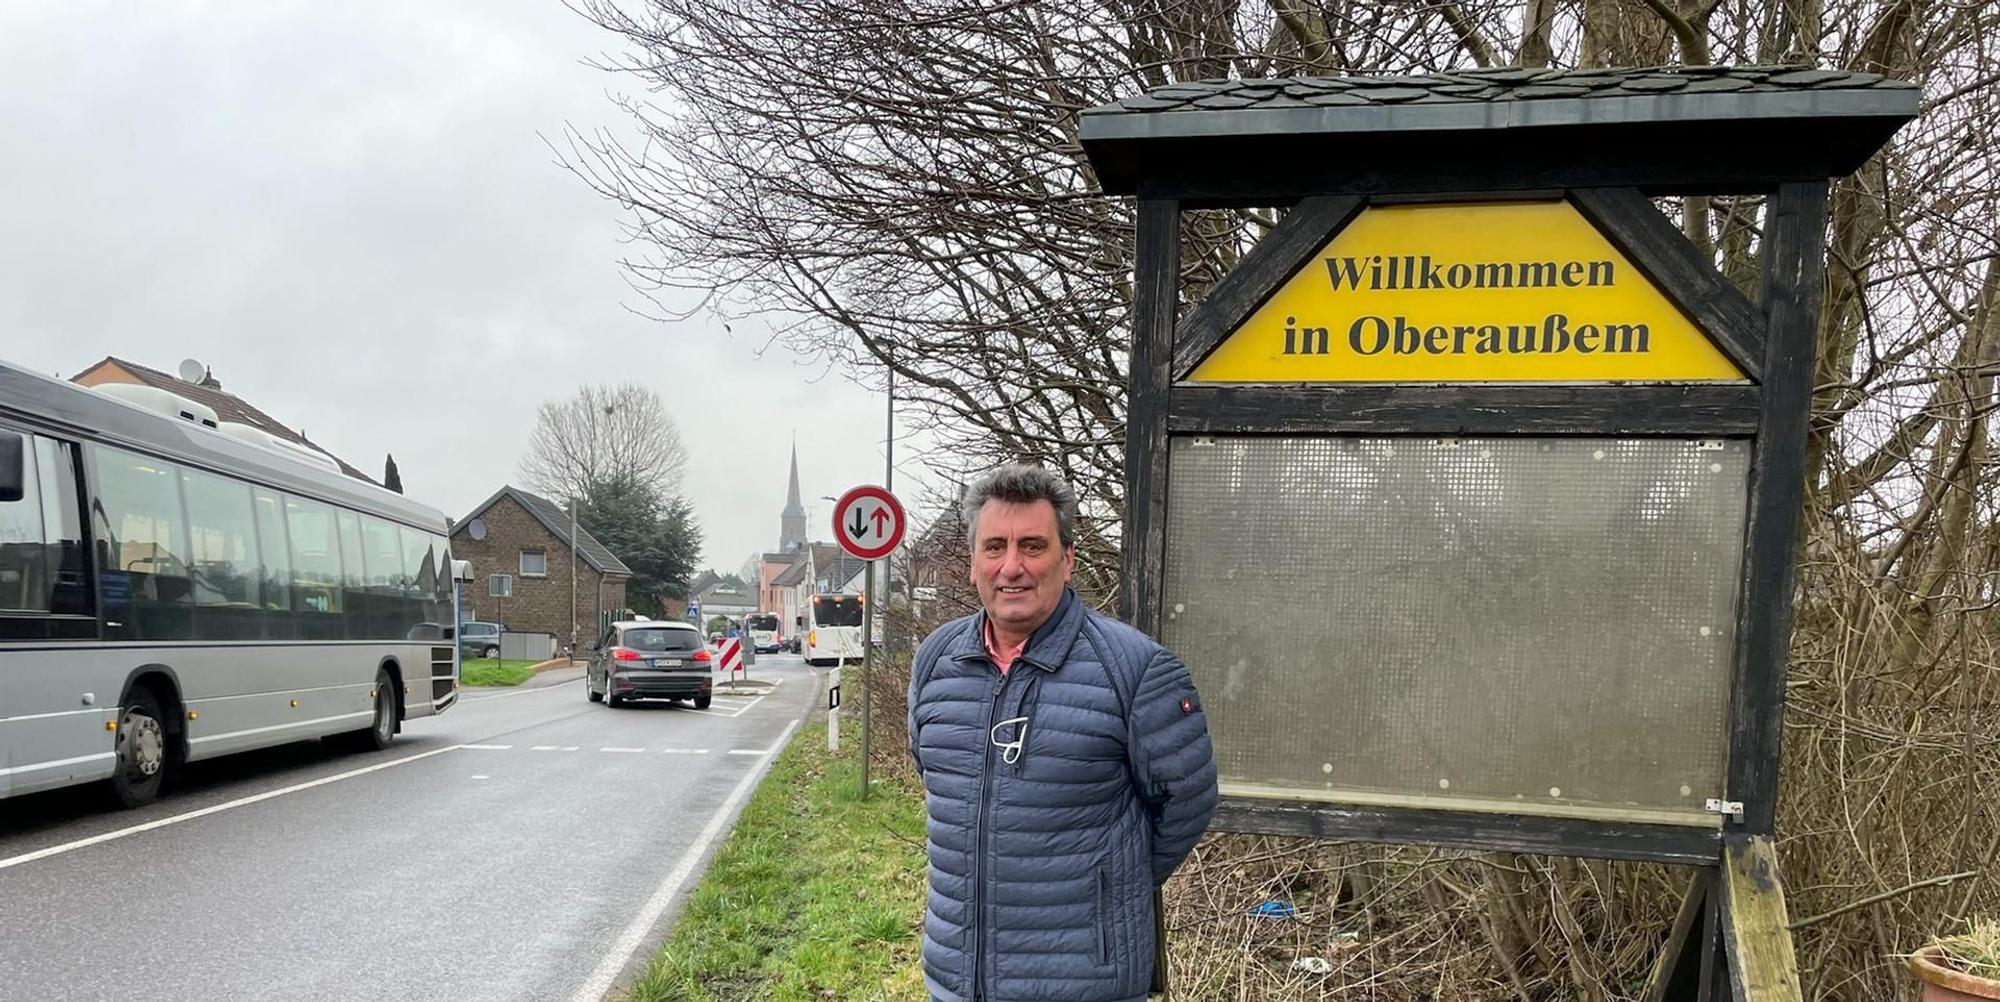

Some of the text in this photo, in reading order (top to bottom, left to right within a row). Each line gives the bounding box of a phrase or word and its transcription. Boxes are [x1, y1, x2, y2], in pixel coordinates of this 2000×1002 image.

[1325, 255, 1616, 291] Willkommen
[1282, 314, 1650, 356] in Oberaußem
